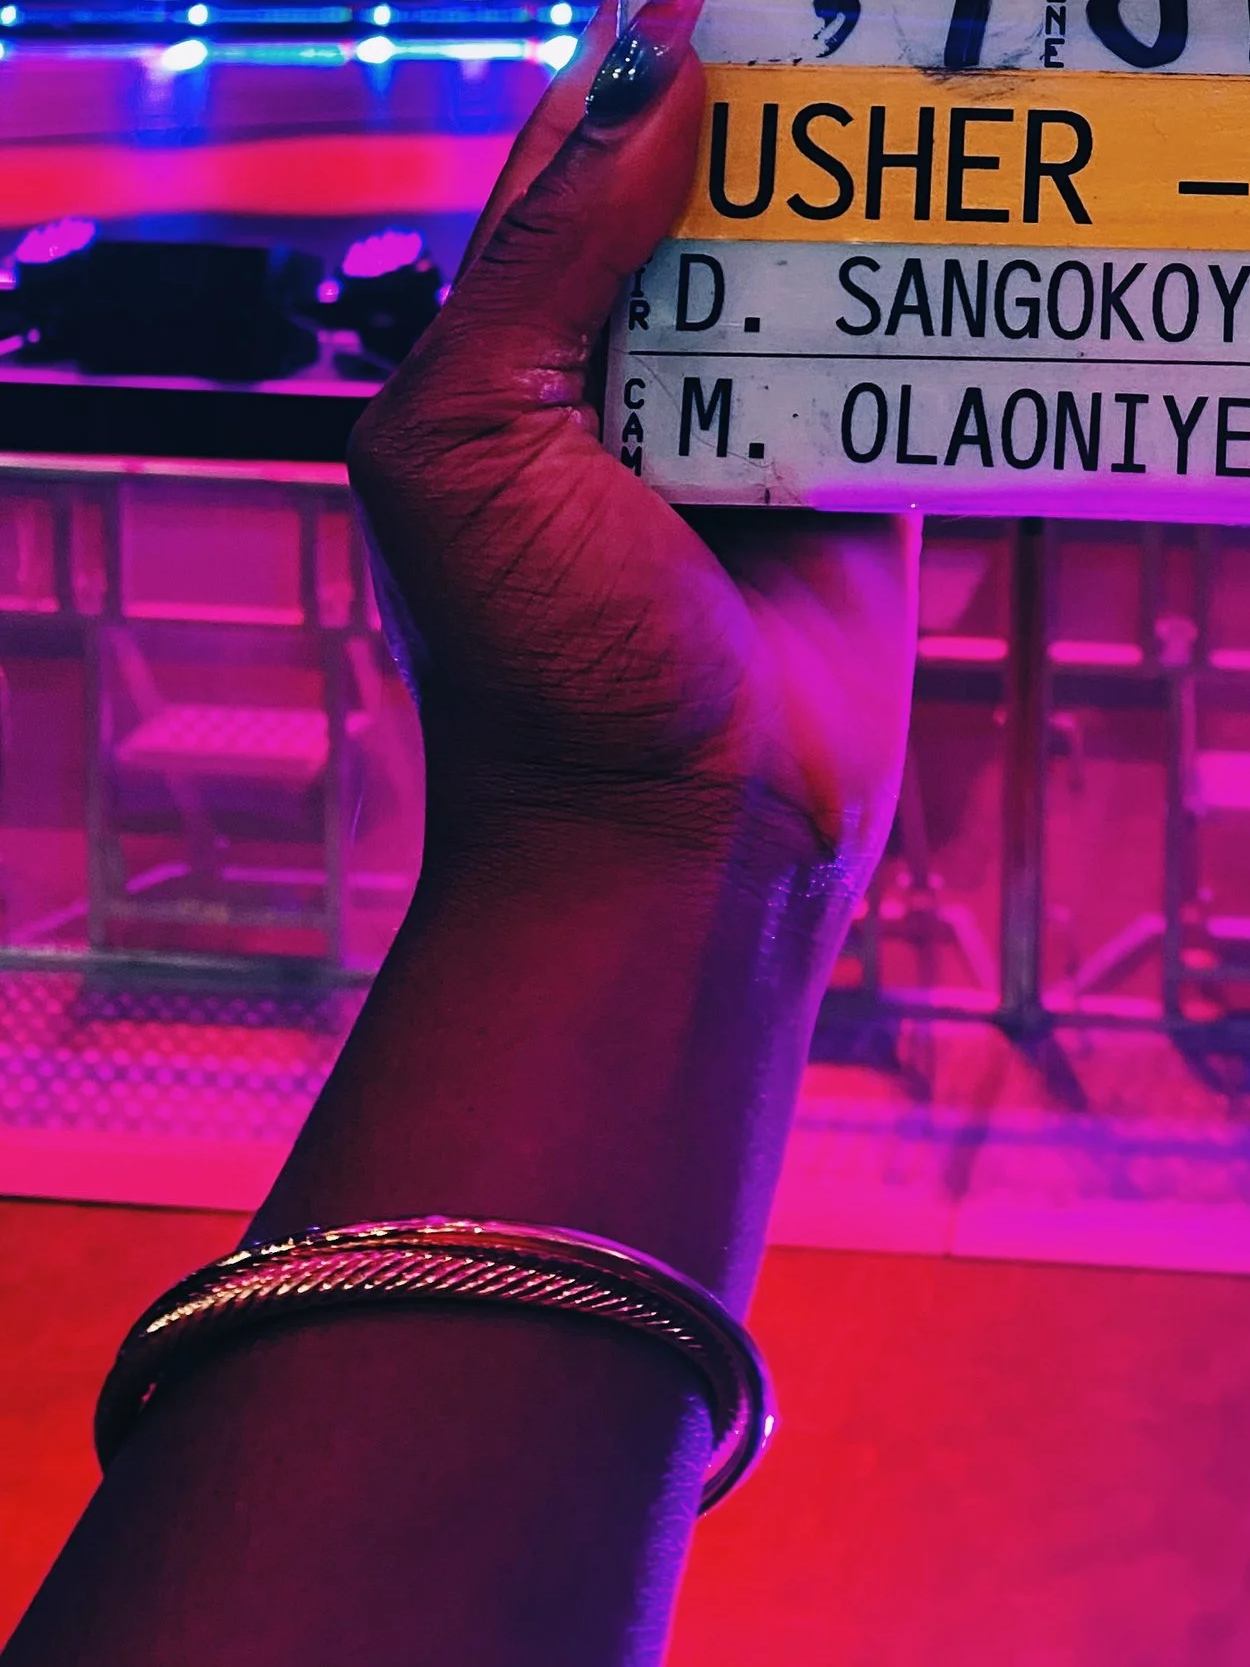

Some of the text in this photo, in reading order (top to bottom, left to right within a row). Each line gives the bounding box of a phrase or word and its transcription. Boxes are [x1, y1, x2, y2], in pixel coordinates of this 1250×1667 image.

[708, 101, 1093, 225] USHER
[628, 256, 652, 331] IR
[675, 253, 761, 333] D.
[620, 378, 646, 477] CAM
[678, 376, 765, 460] M.
